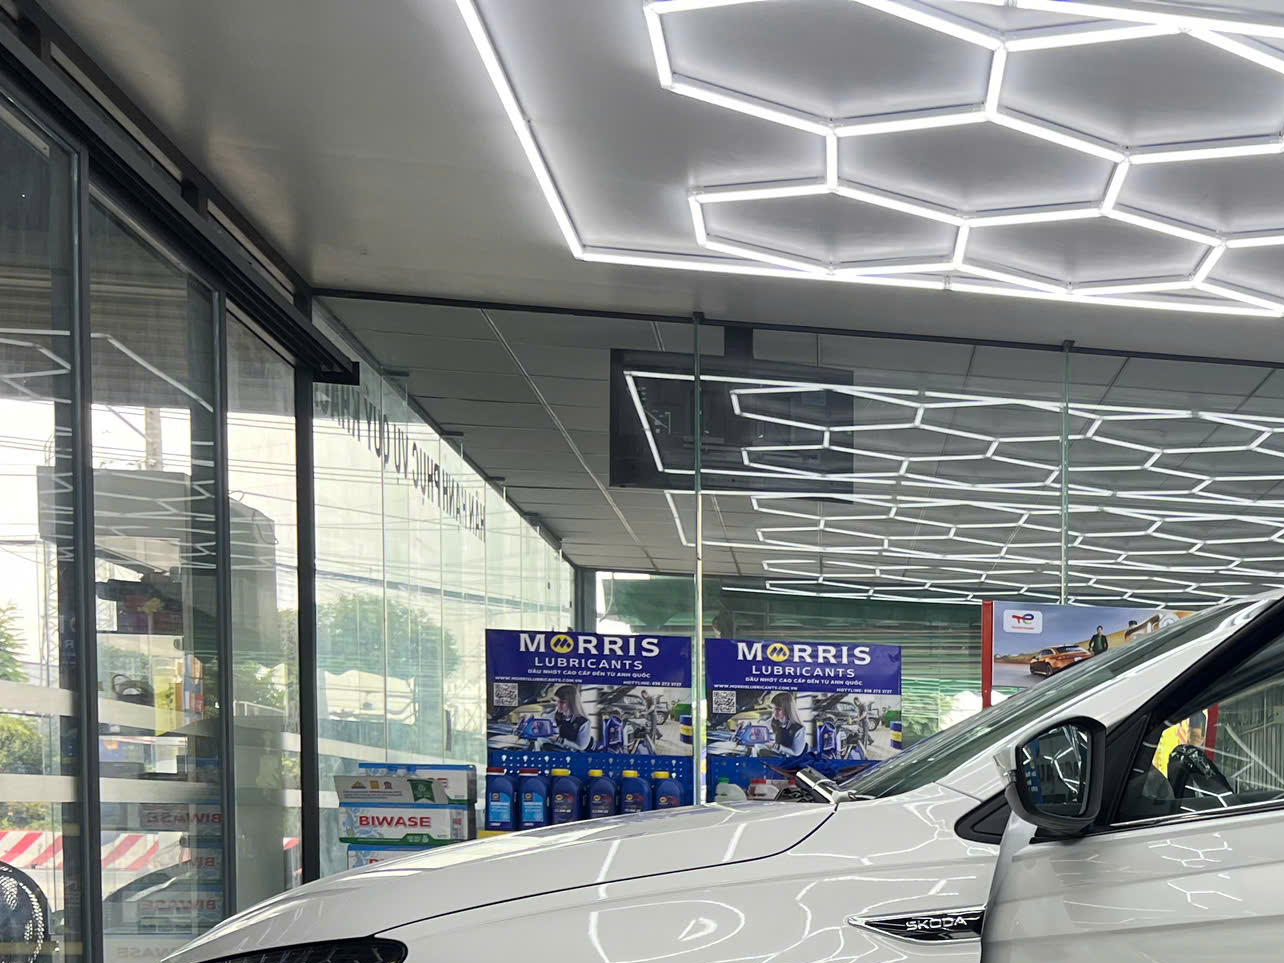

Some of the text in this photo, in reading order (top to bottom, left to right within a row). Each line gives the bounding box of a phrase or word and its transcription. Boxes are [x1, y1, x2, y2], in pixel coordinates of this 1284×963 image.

[519, 633, 661, 657] MORRIS
[737, 642, 872, 665] MORRIS
[534, 657, 643, 670] LUBRICANTS
[752, 665, 856, 678] LUBRICANTS
[359, 815, 431, 828] BIWASE
